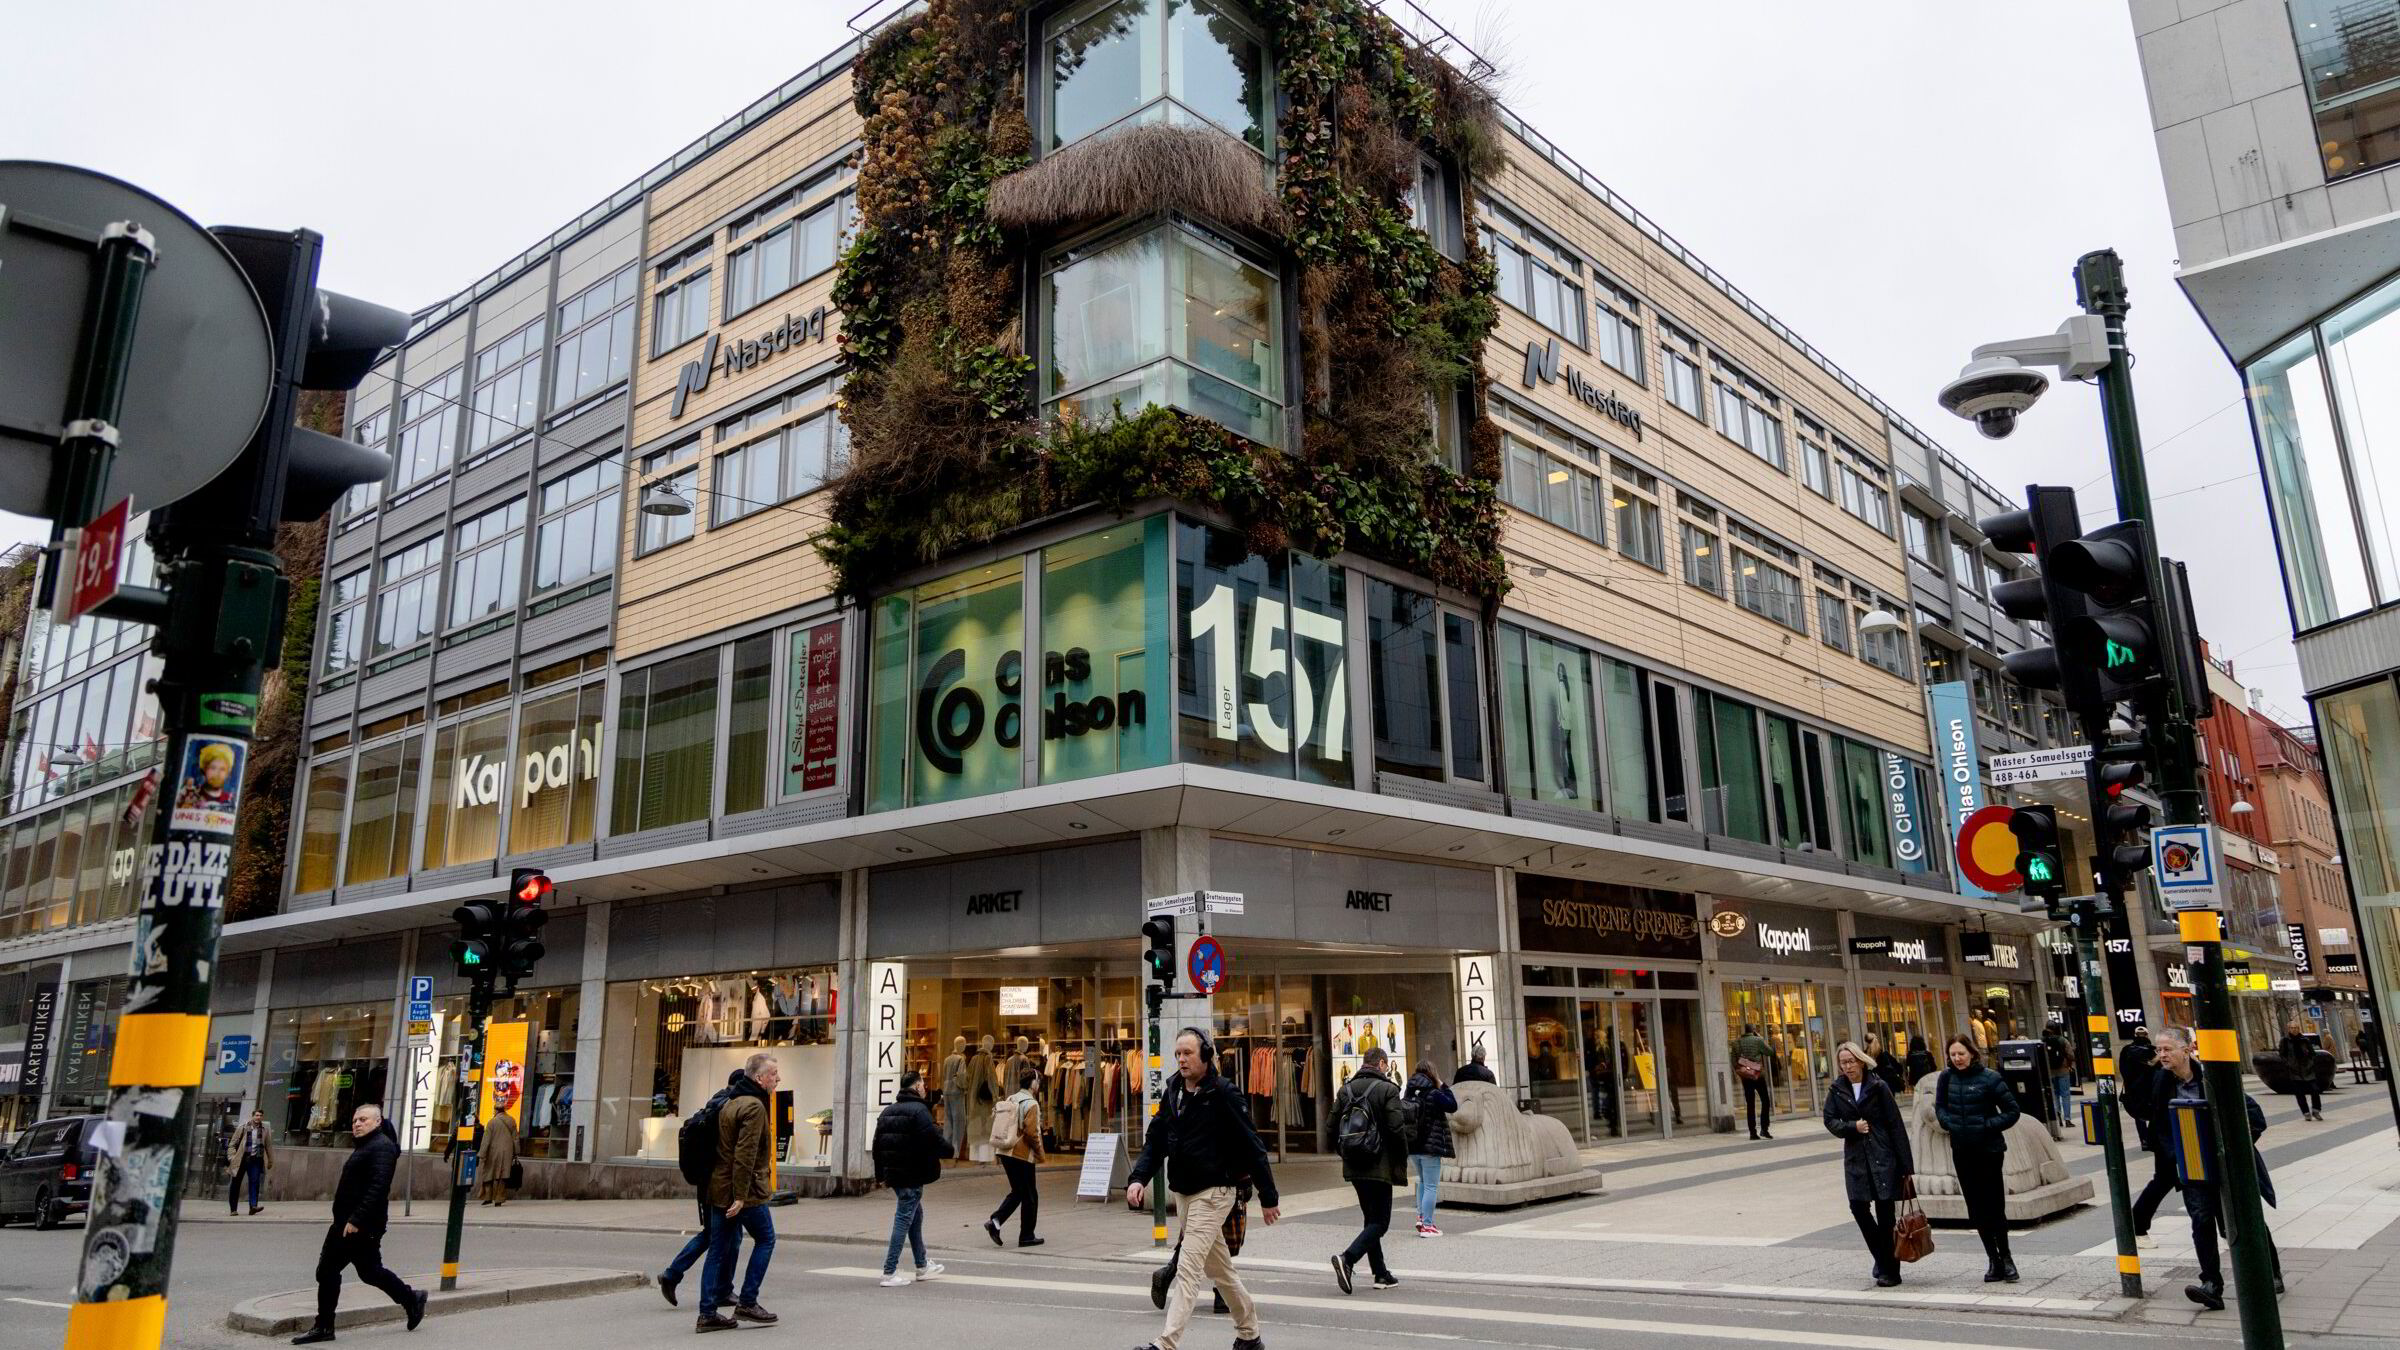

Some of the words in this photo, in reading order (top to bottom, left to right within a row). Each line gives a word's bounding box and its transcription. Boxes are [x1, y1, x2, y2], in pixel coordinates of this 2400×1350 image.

[724, 306, 825, 378] Nasdaq
[1567, 364, 1643, 443] Nasdaq
[812, 646, 837, 664] roligt
[1222, 685, 1234, 730] Lager
[1950, 718, 1970, 783] Ohlson
[1993, 757, 2026, 768] Mäster
[1995, 769, 2038, 783] 48B-46A
[966, 890, 1023, 915] ARKET
[1345, 890, 1392, 912] ARKET
[1543, 899, 1632, 937] SØSTRENE
[1633, 908, 1684, 942] GRENE
[1757, 923, 1810, 956] Kappahl
[1856, 940, 1886, 949] Kappahl
[1888, 939, 1926, 964] appahl
[2288, 925, 2309, 972] SCORETT
[2328, 965, 2358, 973] SCORETT
[416, 979, 429, 1000] P
[25, 992, 52, 1086] KARTBUTIKEN
[219, 1050, 236, 1069] P
